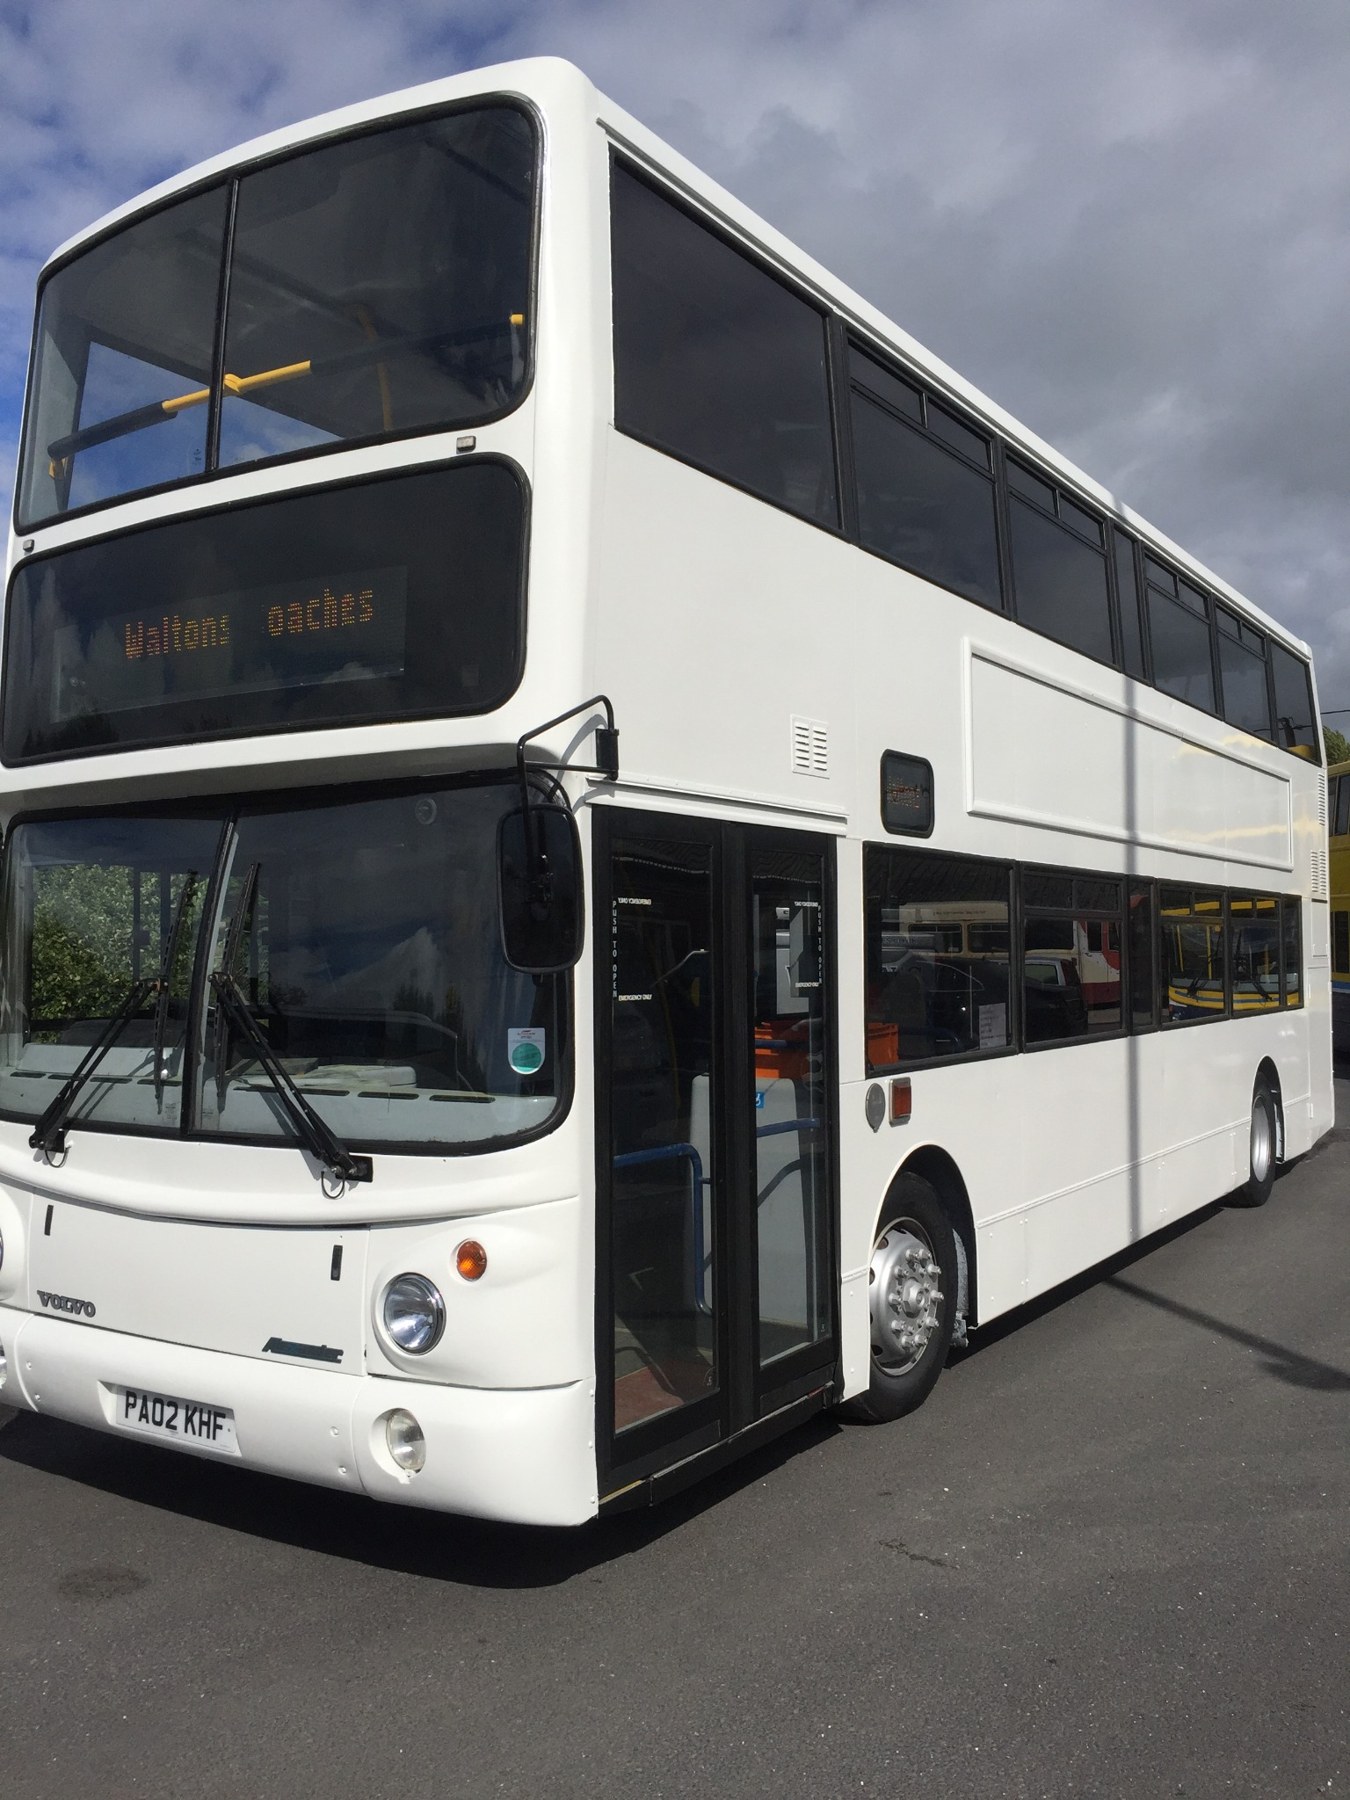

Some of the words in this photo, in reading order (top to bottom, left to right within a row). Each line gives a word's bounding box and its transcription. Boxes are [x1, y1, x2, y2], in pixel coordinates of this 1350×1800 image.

[125, 615, 230, 659] Waltons
[261, 588, 373, 637] oaches
[612, 941, 618, 958] TO
[37, 1290, 97, 1318] VOLVO
[124, 1390, 178, 1431] PA02
[184, 1405, 227, 1441] KHF
